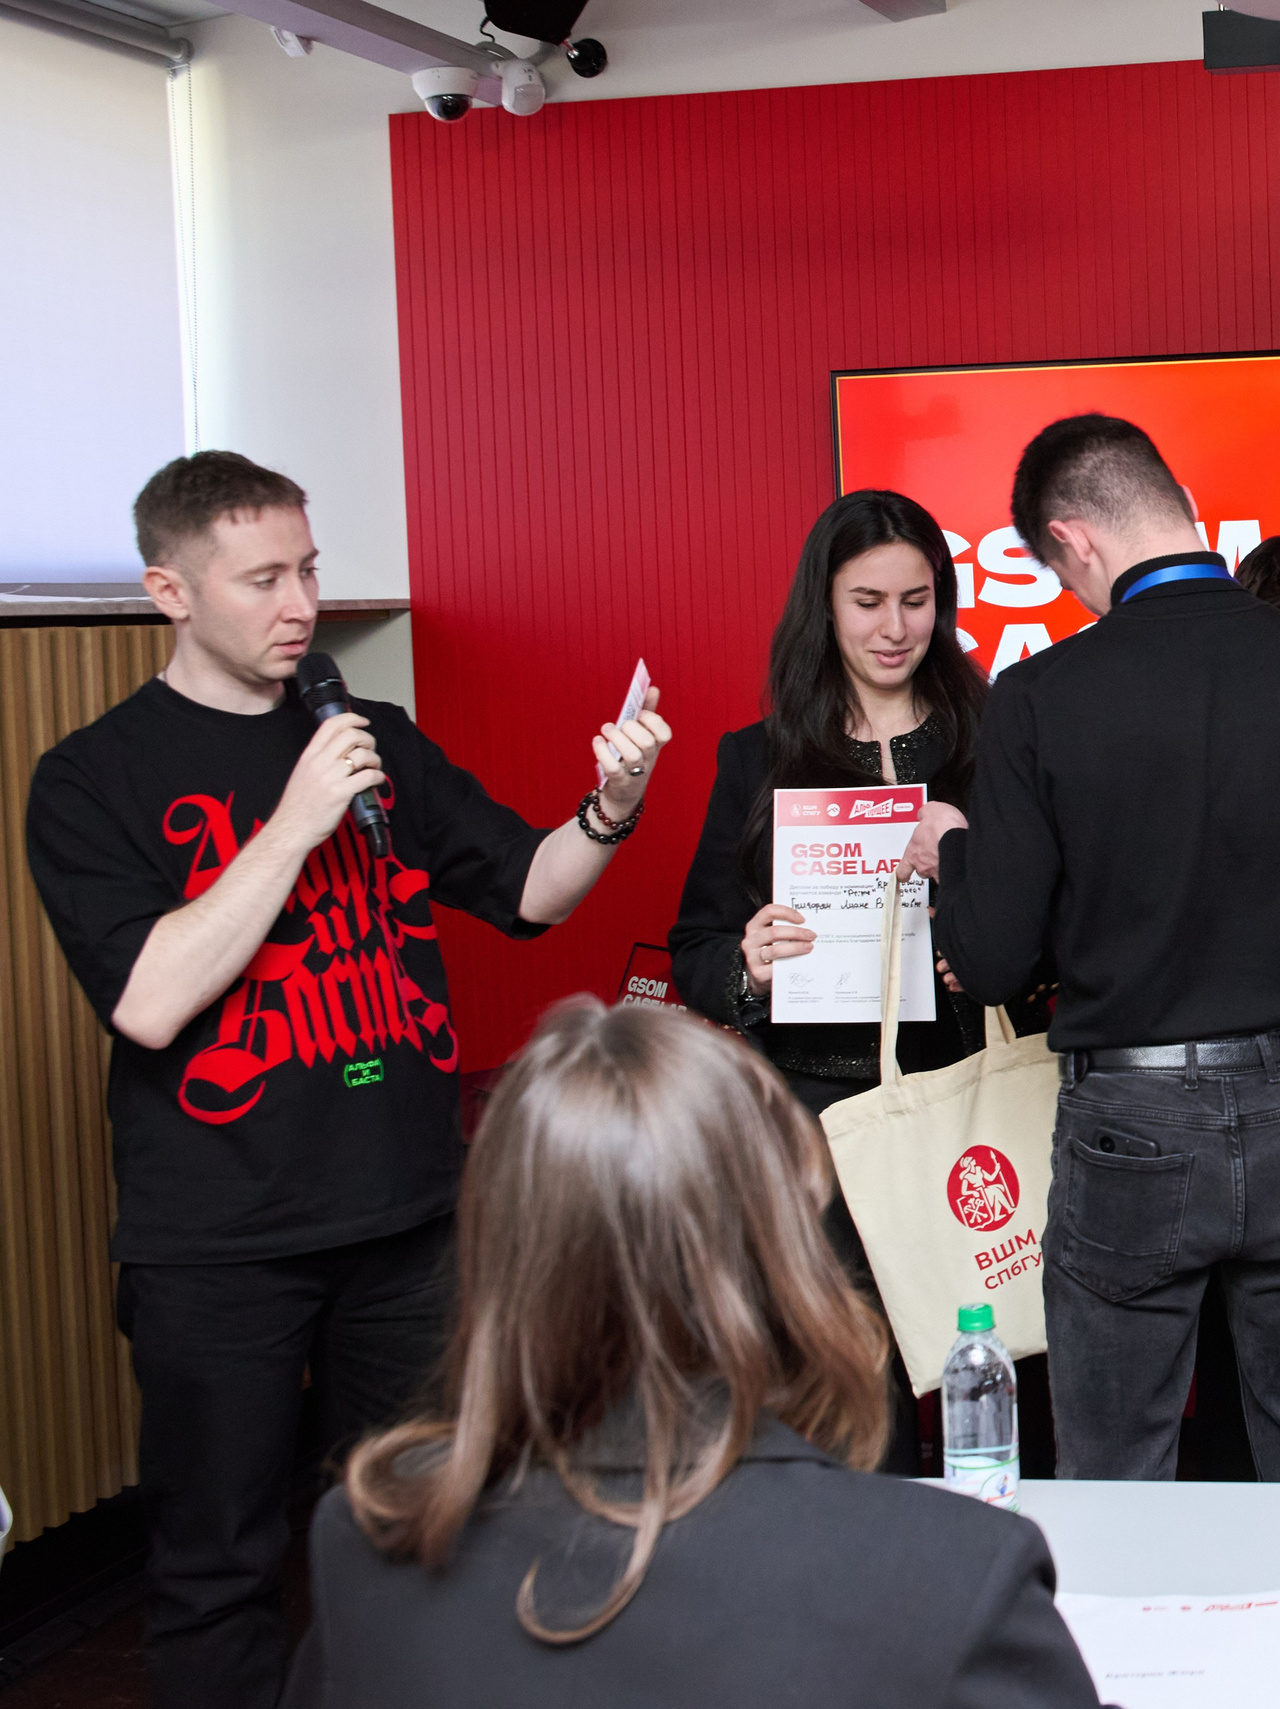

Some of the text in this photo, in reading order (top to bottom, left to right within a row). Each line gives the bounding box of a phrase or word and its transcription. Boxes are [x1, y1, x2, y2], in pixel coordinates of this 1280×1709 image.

[791, 842, 863, 858] GSOM
[790, 860, 857, 876] CASE
[628, 976, 668, 998] GSOM
[975, 1229, 1037, 1270] ВШМ
